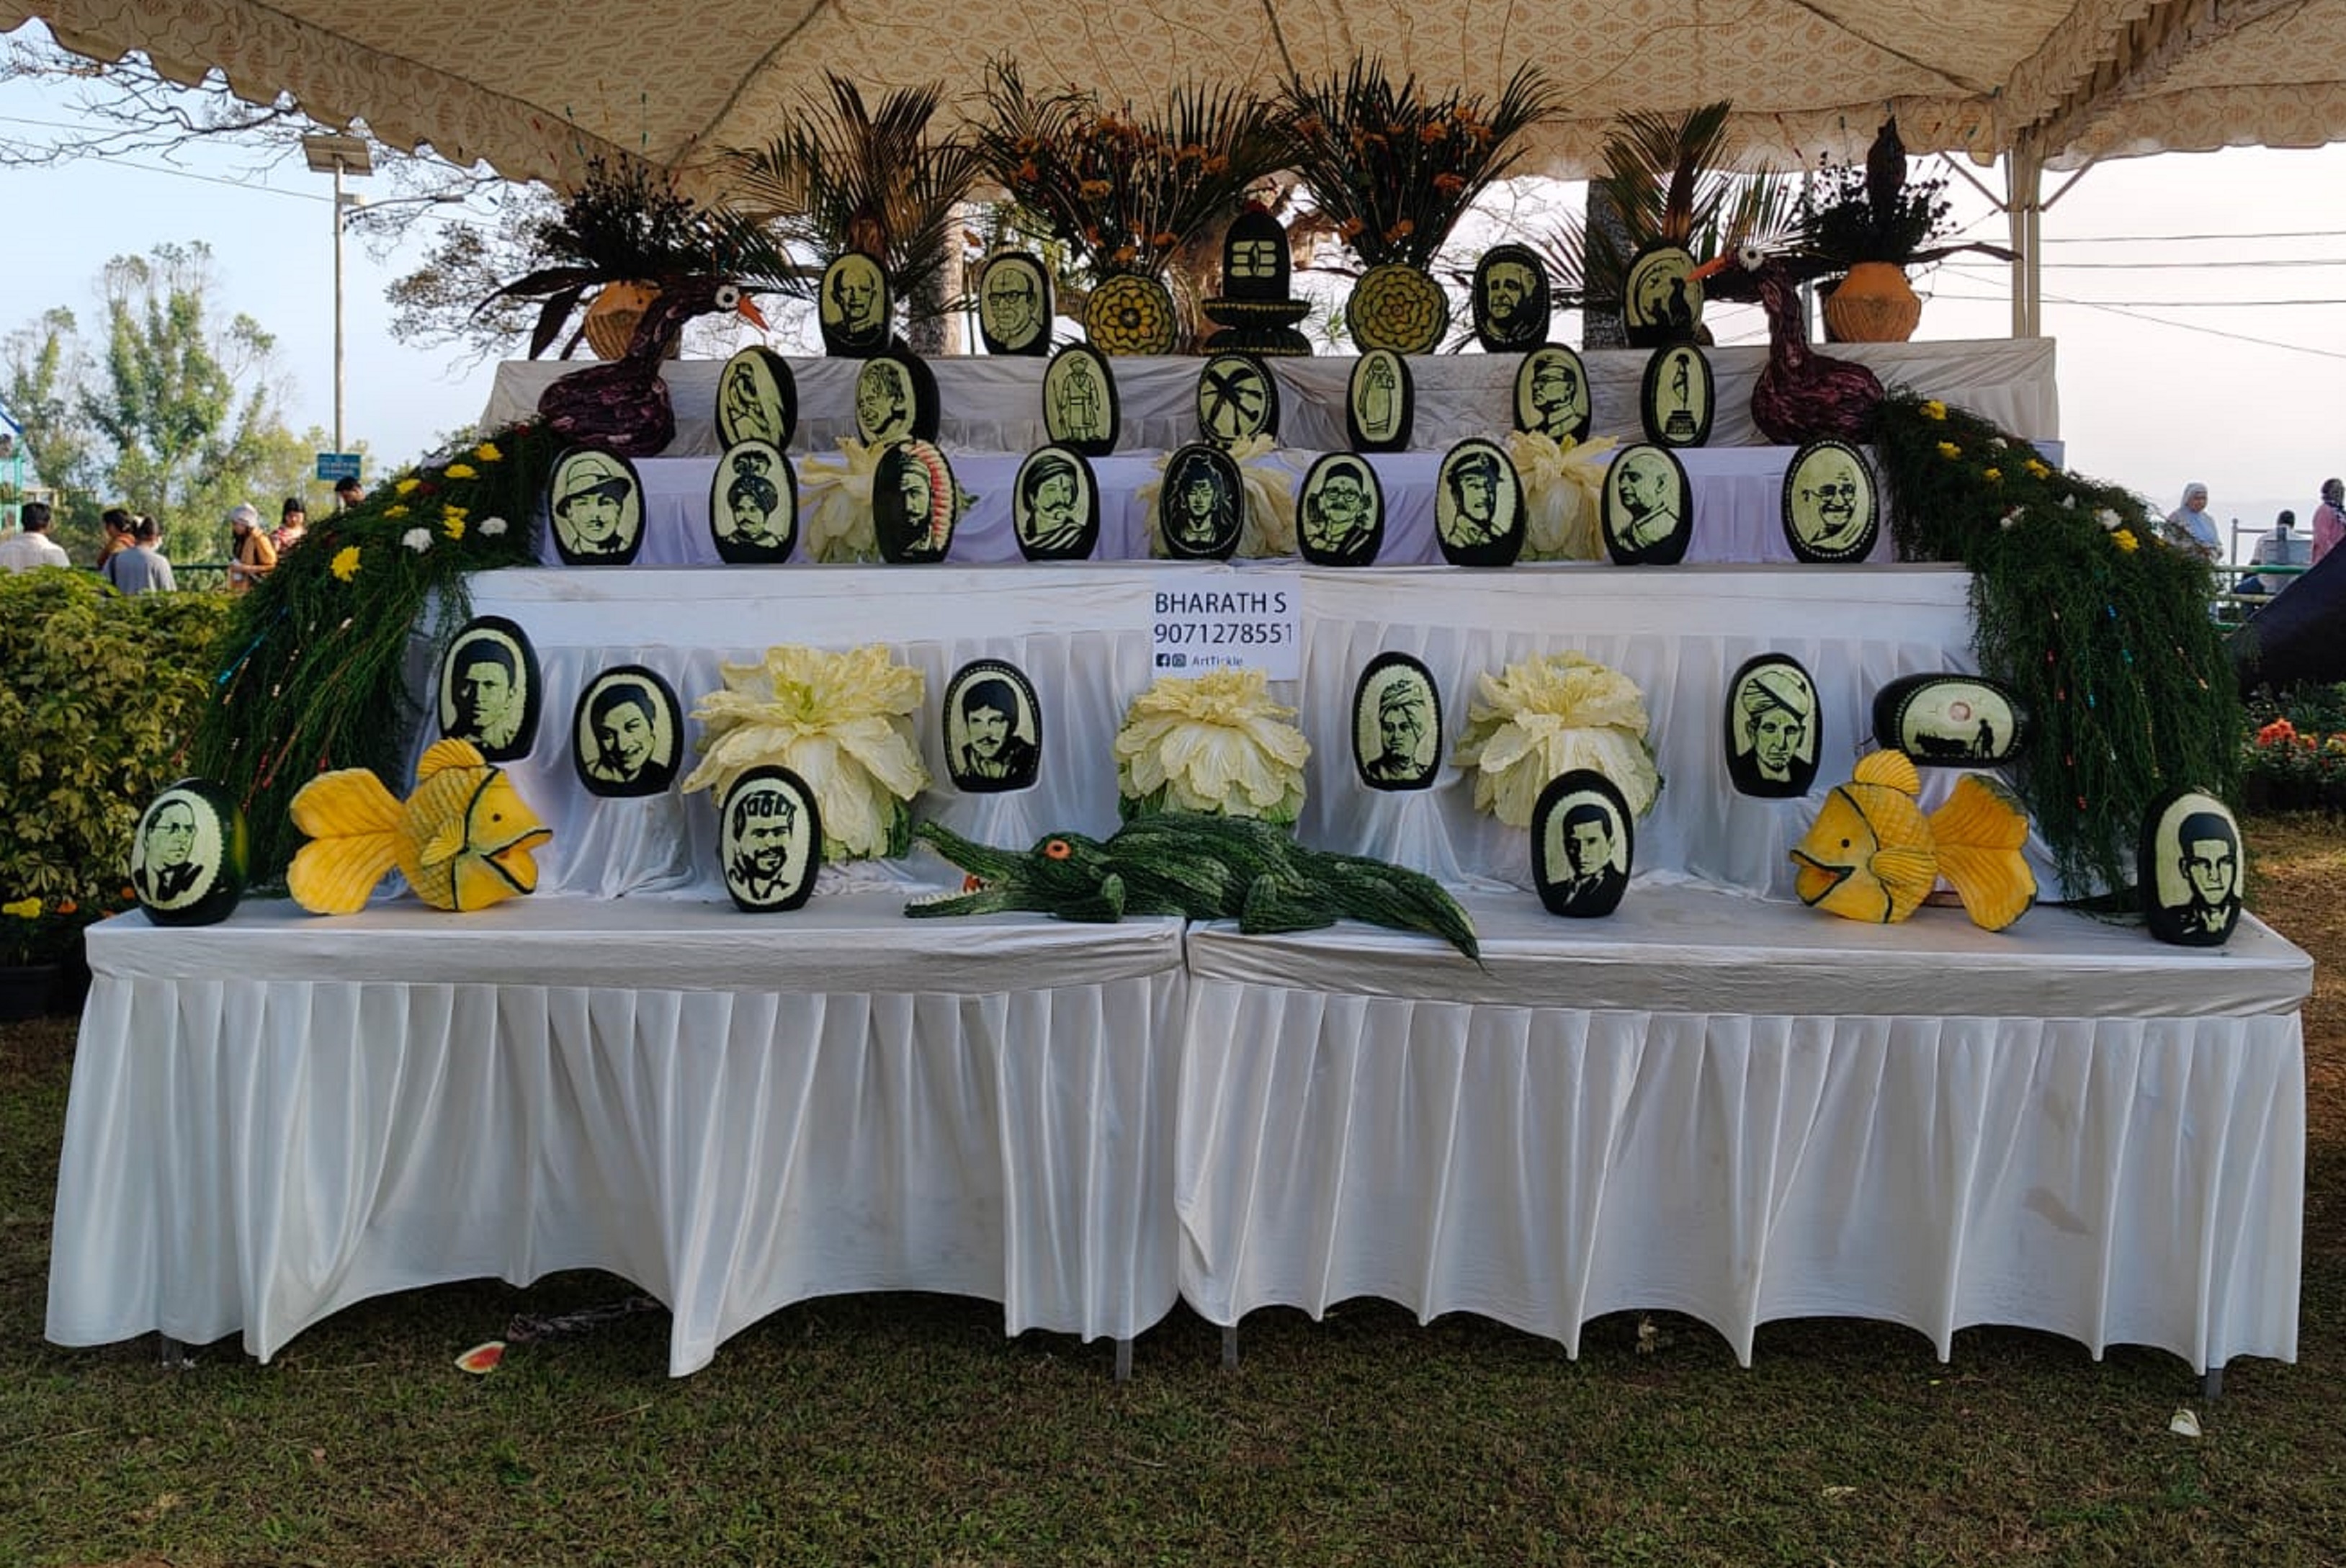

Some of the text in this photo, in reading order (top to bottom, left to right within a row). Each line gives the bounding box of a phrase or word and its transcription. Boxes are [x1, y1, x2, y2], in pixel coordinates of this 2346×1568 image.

[1155, 592, 1286, 613] BHARATH S
[1154, 623, 1291, 643] 9071278551
